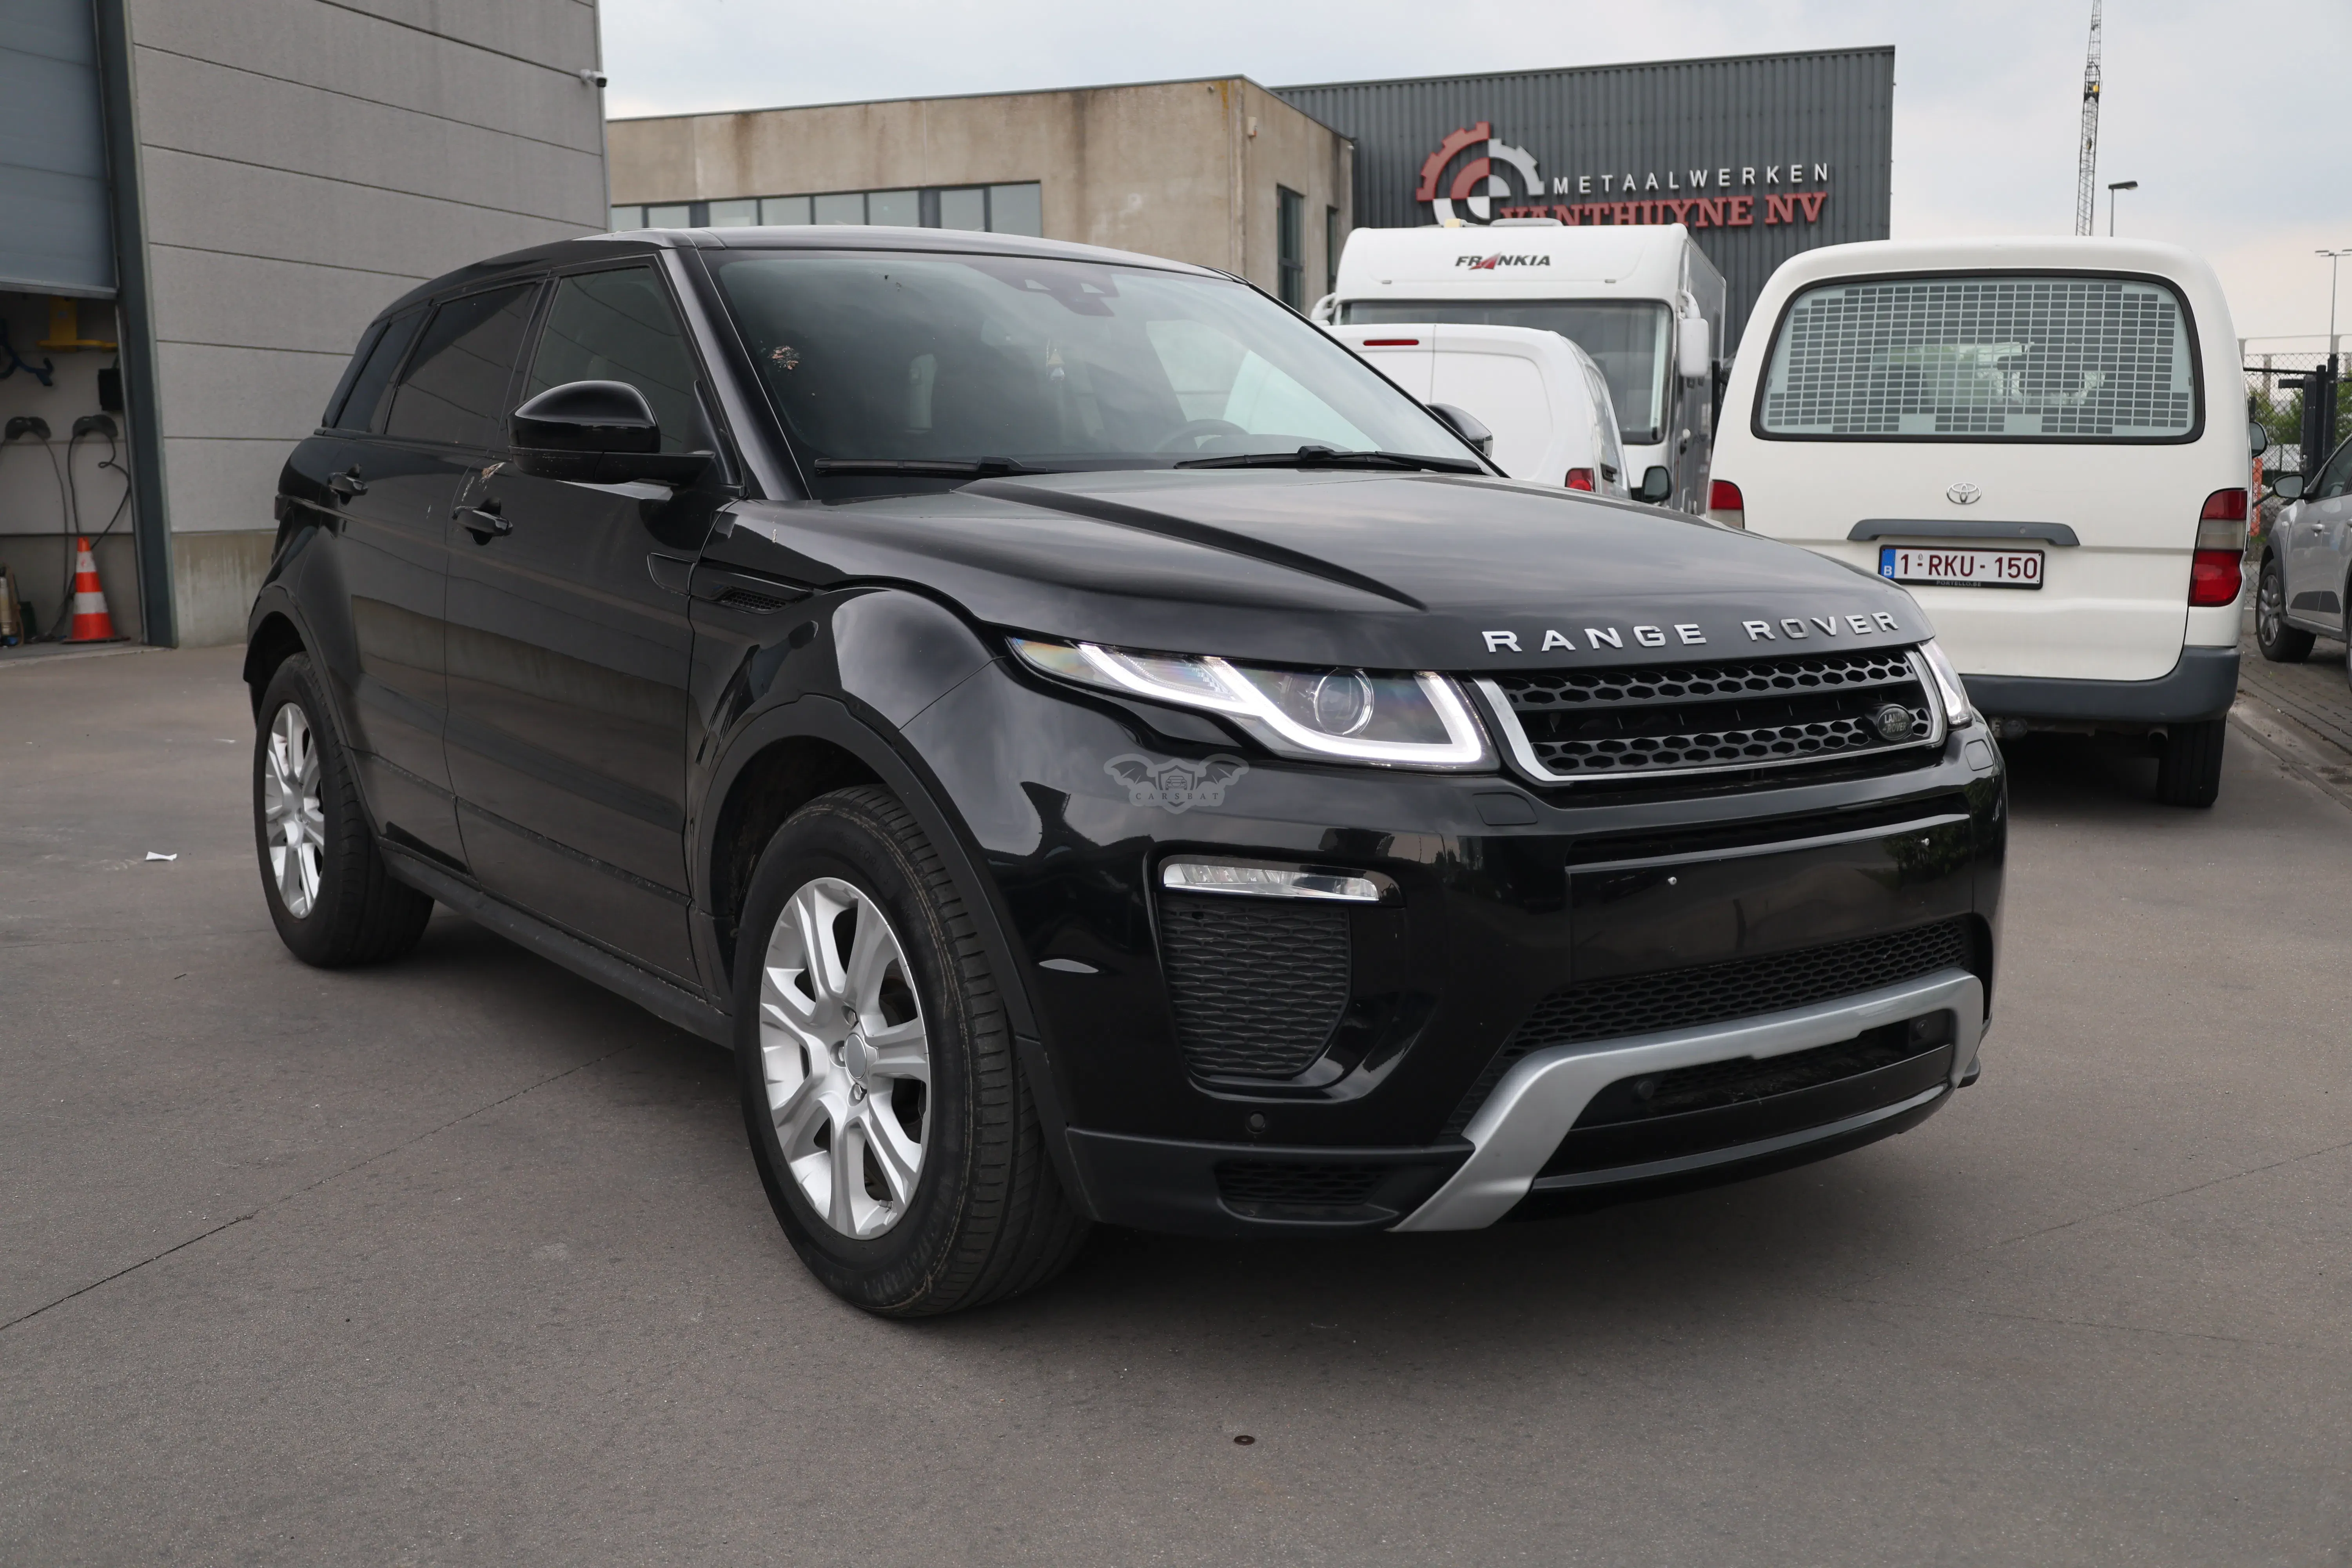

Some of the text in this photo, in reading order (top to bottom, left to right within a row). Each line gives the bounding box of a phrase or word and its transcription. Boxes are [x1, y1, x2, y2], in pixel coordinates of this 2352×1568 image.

[1553, 163, 1828, 194] METAALWERKEN
[1764, 192, 1827, 225] NV
[1455, 251, 1551, 270] FRANKIA
[1883, 566, 1893, 576] B
[1482, 611, 1899, 652] RANGE ROVER
[1885, 713, 1902, 724] LAND
[1887, 722, 1907, 733] ROVER
